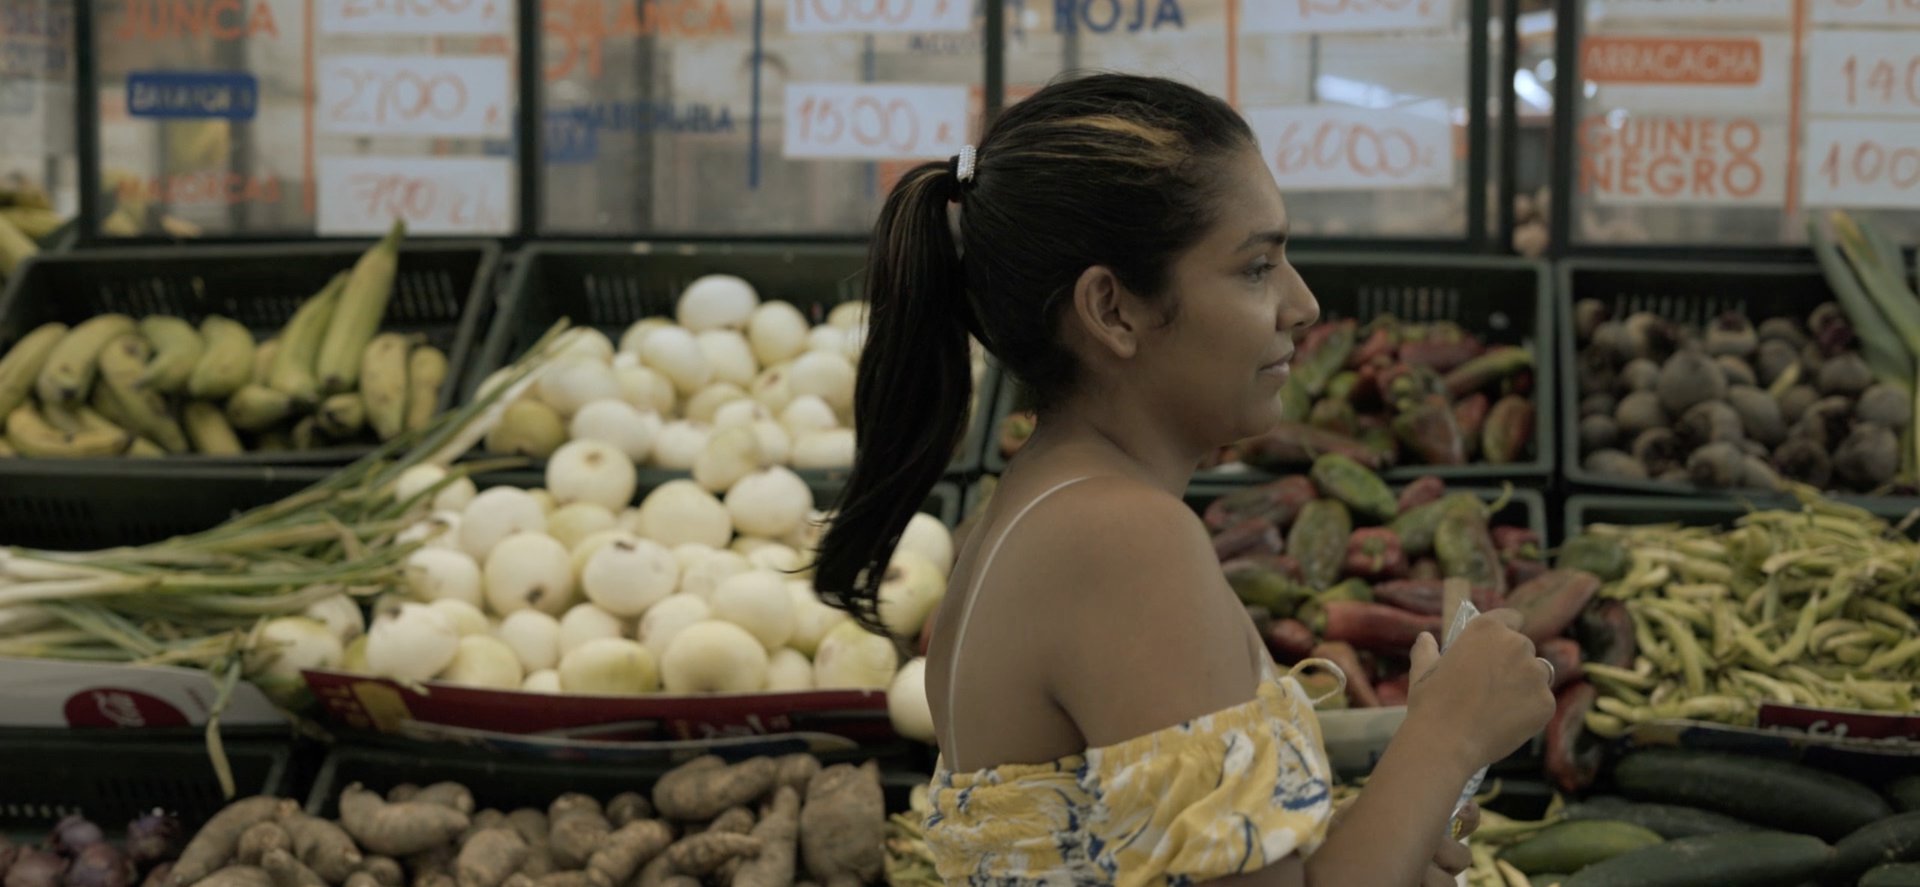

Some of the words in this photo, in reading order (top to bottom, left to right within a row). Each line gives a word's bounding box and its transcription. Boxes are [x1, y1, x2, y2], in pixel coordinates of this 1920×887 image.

[117, 0, 279, 40] JUNCA
[1054, 0, 1184, 34] ROJA
[1586, 44, 1756, 79] ARRACACHA
[798, 96, 921, 152] 1500
[1578, 115, 1762, 158] GUINEO
[1277, 120, 1418, 177] 6000
[1578, 155, 1764, 198] NEGRO
